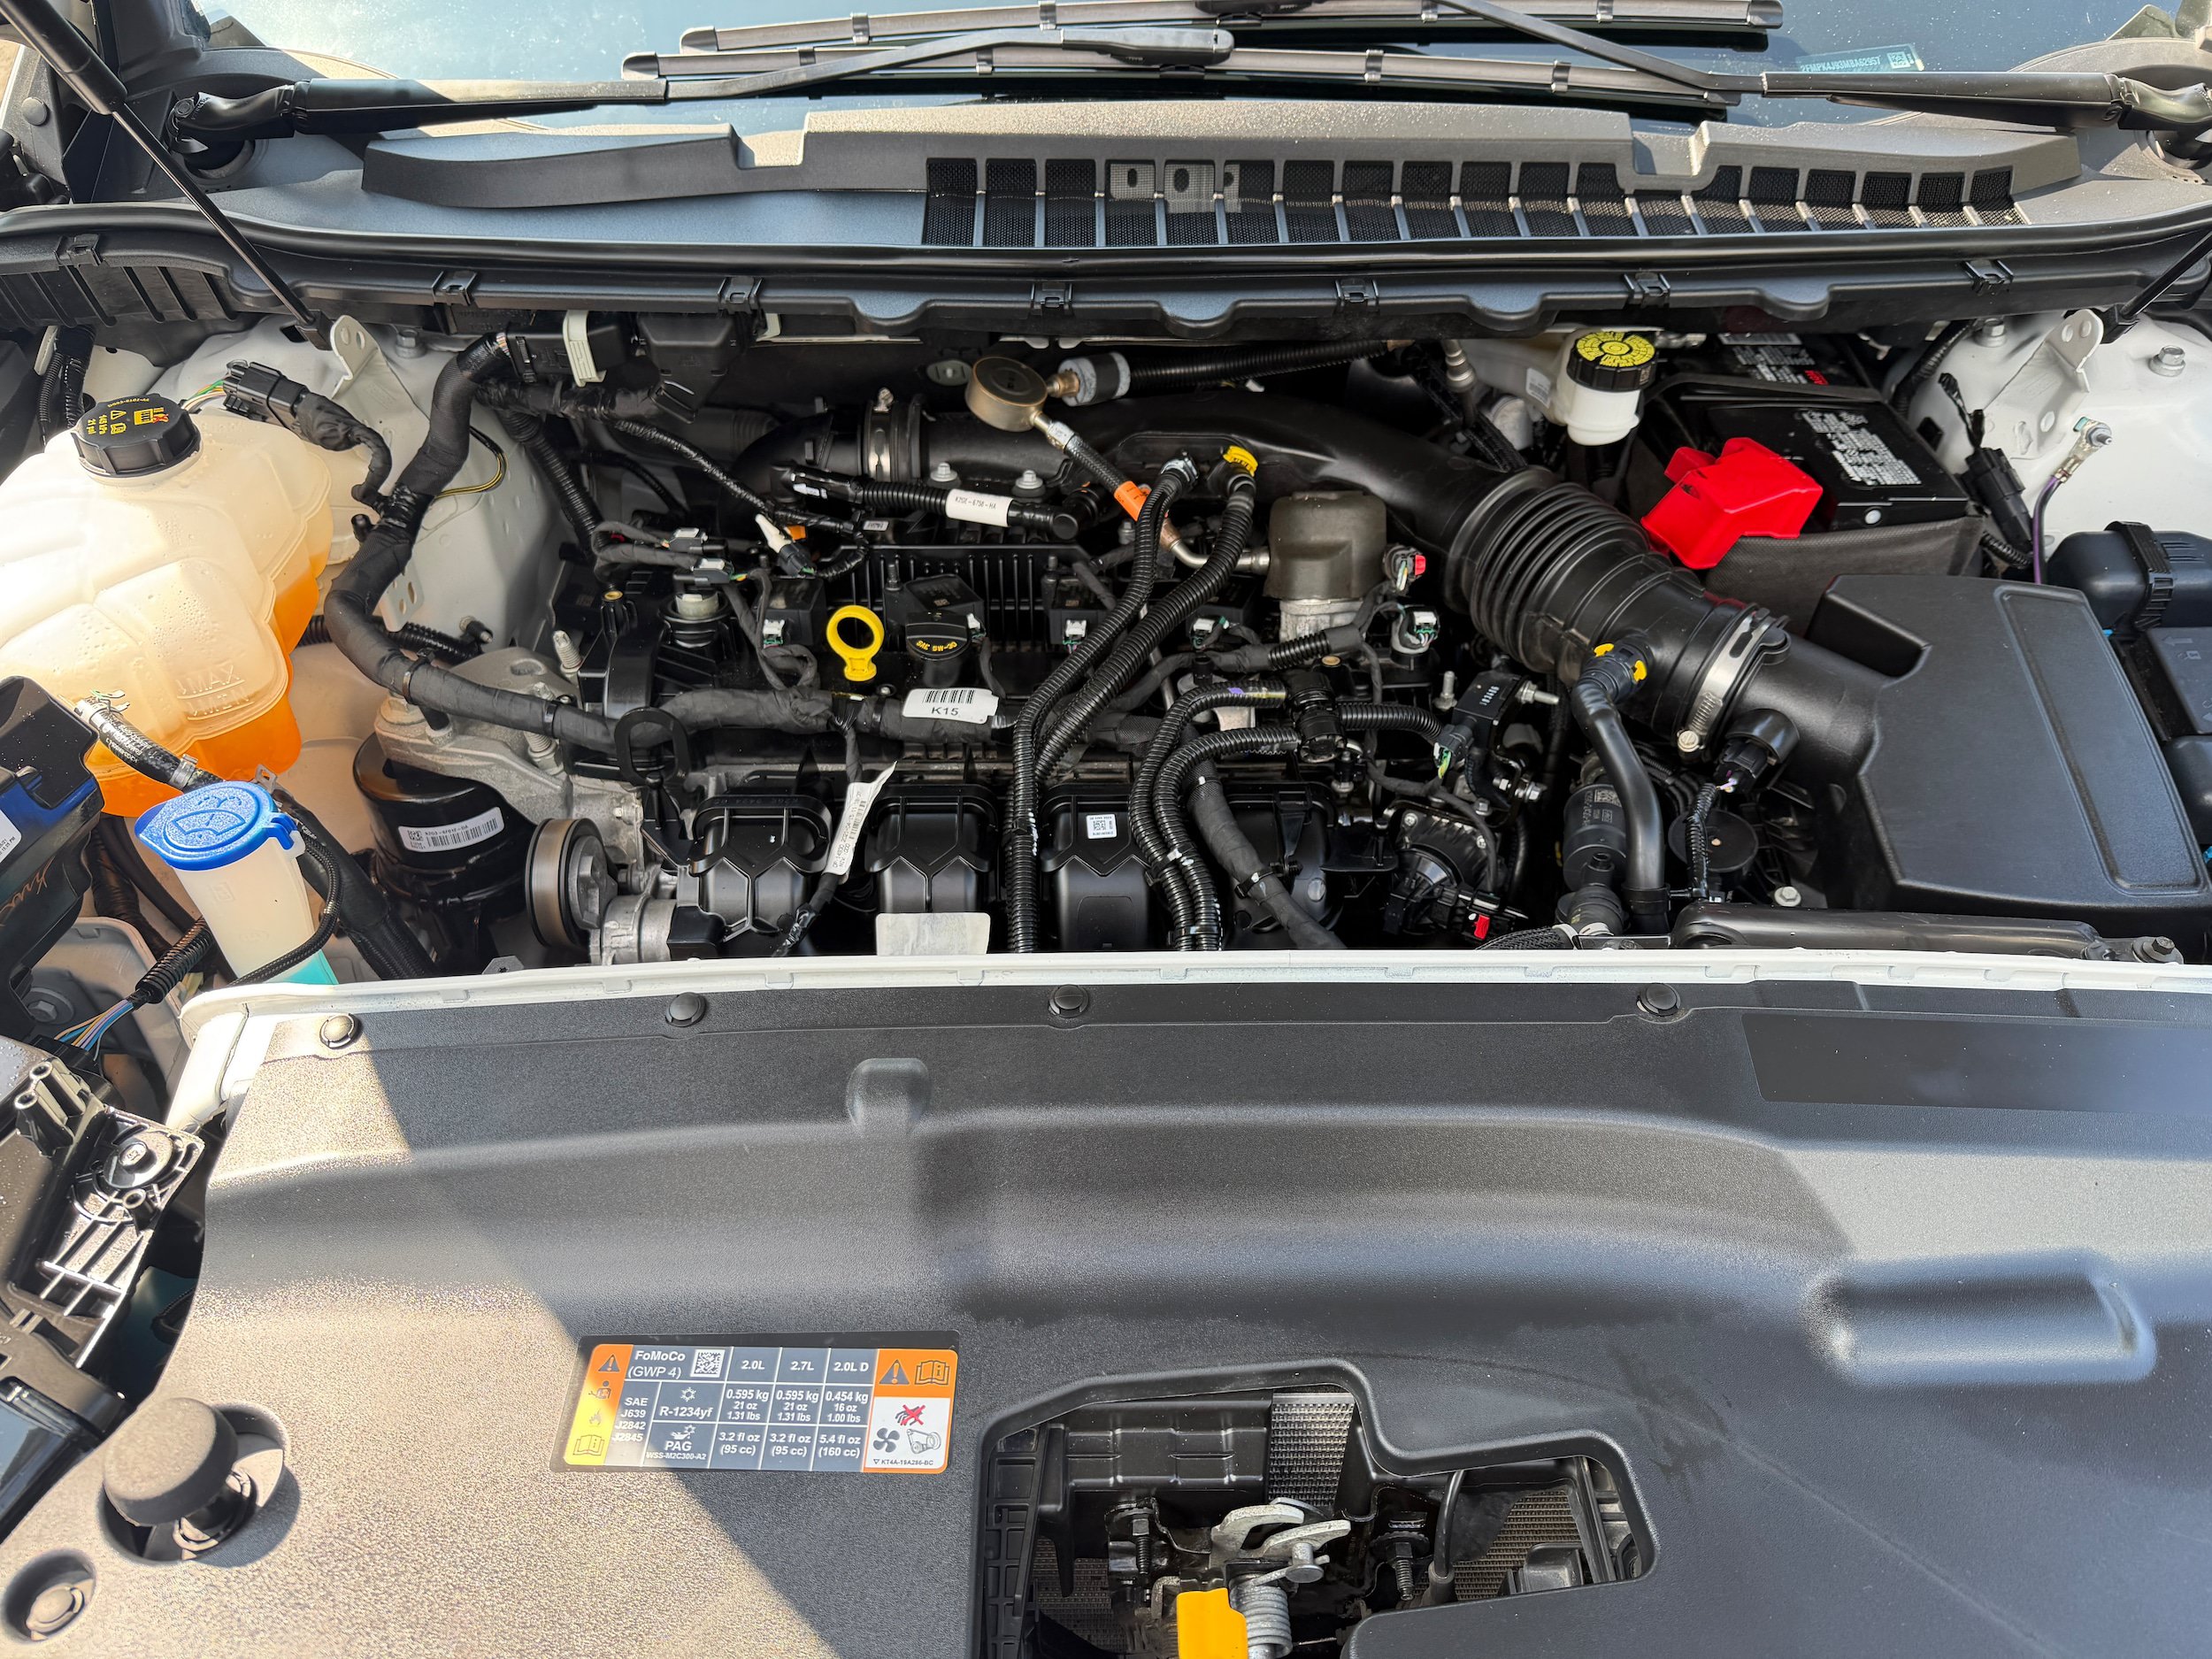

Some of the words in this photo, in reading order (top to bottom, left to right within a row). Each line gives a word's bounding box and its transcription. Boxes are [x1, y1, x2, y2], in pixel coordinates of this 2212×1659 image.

[931, 707, 959, 716] K15
[634, 1350, 686, 1361] FoMoCo
[741, 1360, 765, 1370] 2.0L
[790, 1361, 814, 1371] 2.7L
[833, 1362, 857, 1371] 2.0L
[860, 1363, 869, 1371] D
[628, 1366, 666, 1379] (GWP
[668, 1366, 682, 1379] 4)
[726, 1389, 754, 1399] 0.595
[757, 1390, 769, 1402] kg
[776, 1391, 803, 1400] 0.595
[806, 1392, 819, 1402] kg
[825, 1392, 853, 1402] 0.454
[856, 1393, 869, 1403] kg
[833, 1403, 844, 1412] 16
[659, 1407, 713, 1419] R-1234yf
[797, 1413, 810, 1422] lbs
[848, 1414, 861, 1423] lbs
[615, 1421, 646, 1430] J2842
[612, 1433, 643, 1442] J2845
[718, 1432, 736, 1441] 3.2
[738, 1432, 746, 1441] fl
[770, 1433, 786, 1442] 3.2
[788, 1433, 796, 1442] fl
[838, 1435, 846, 1444] fl
[664, 1440, 692, 1451] PAG
[720, 1445, 738, 1455] (95
[740, 1446, 756, 1455] cc)
[646, 1451, 707, 1460] WSS-M2C300-A2
[772, 1446, 788, 1456] (95
[791, 1447, 807, 1457] cc)
[819, 1448, 842, 1457] (160
[844, 1448, 860, 1458] cc)
